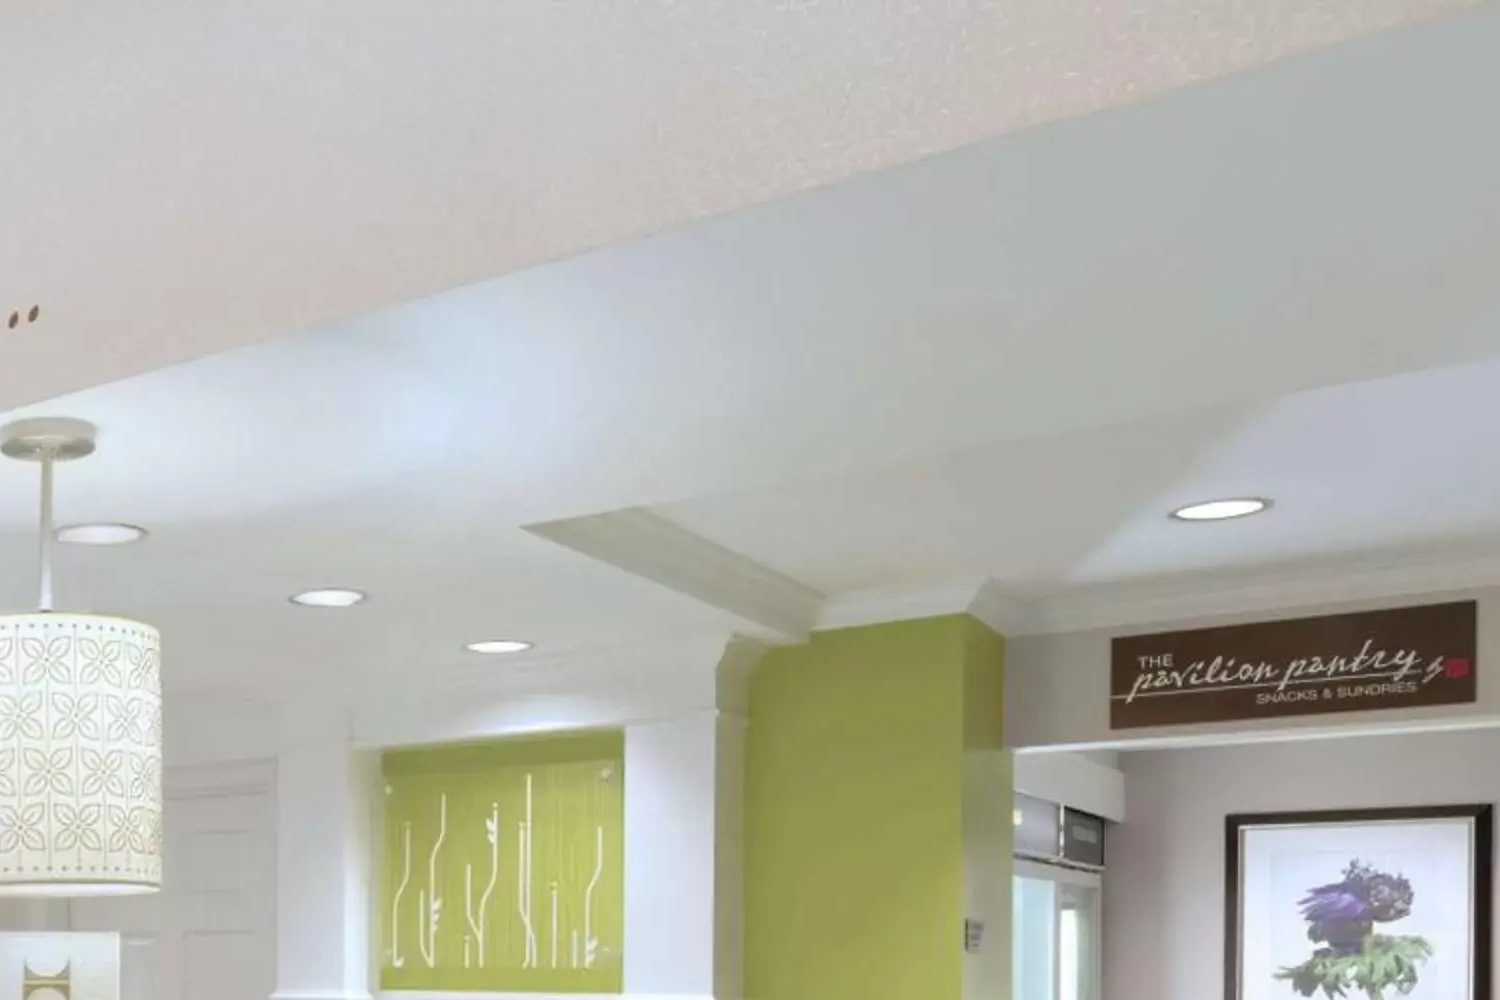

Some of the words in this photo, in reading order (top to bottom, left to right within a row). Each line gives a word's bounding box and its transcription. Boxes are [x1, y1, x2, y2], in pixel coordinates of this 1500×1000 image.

[1125, 655, 1277, 705] pavilion
[1279, 639, 1419, 691] pantry
[1138, 654, 1174, 669] THE
[1255, 691, 1319, 705] SNACKS
[1322, 688, 1335, 700] &
[1337, 681, 1419, 698] SUNDRIES
